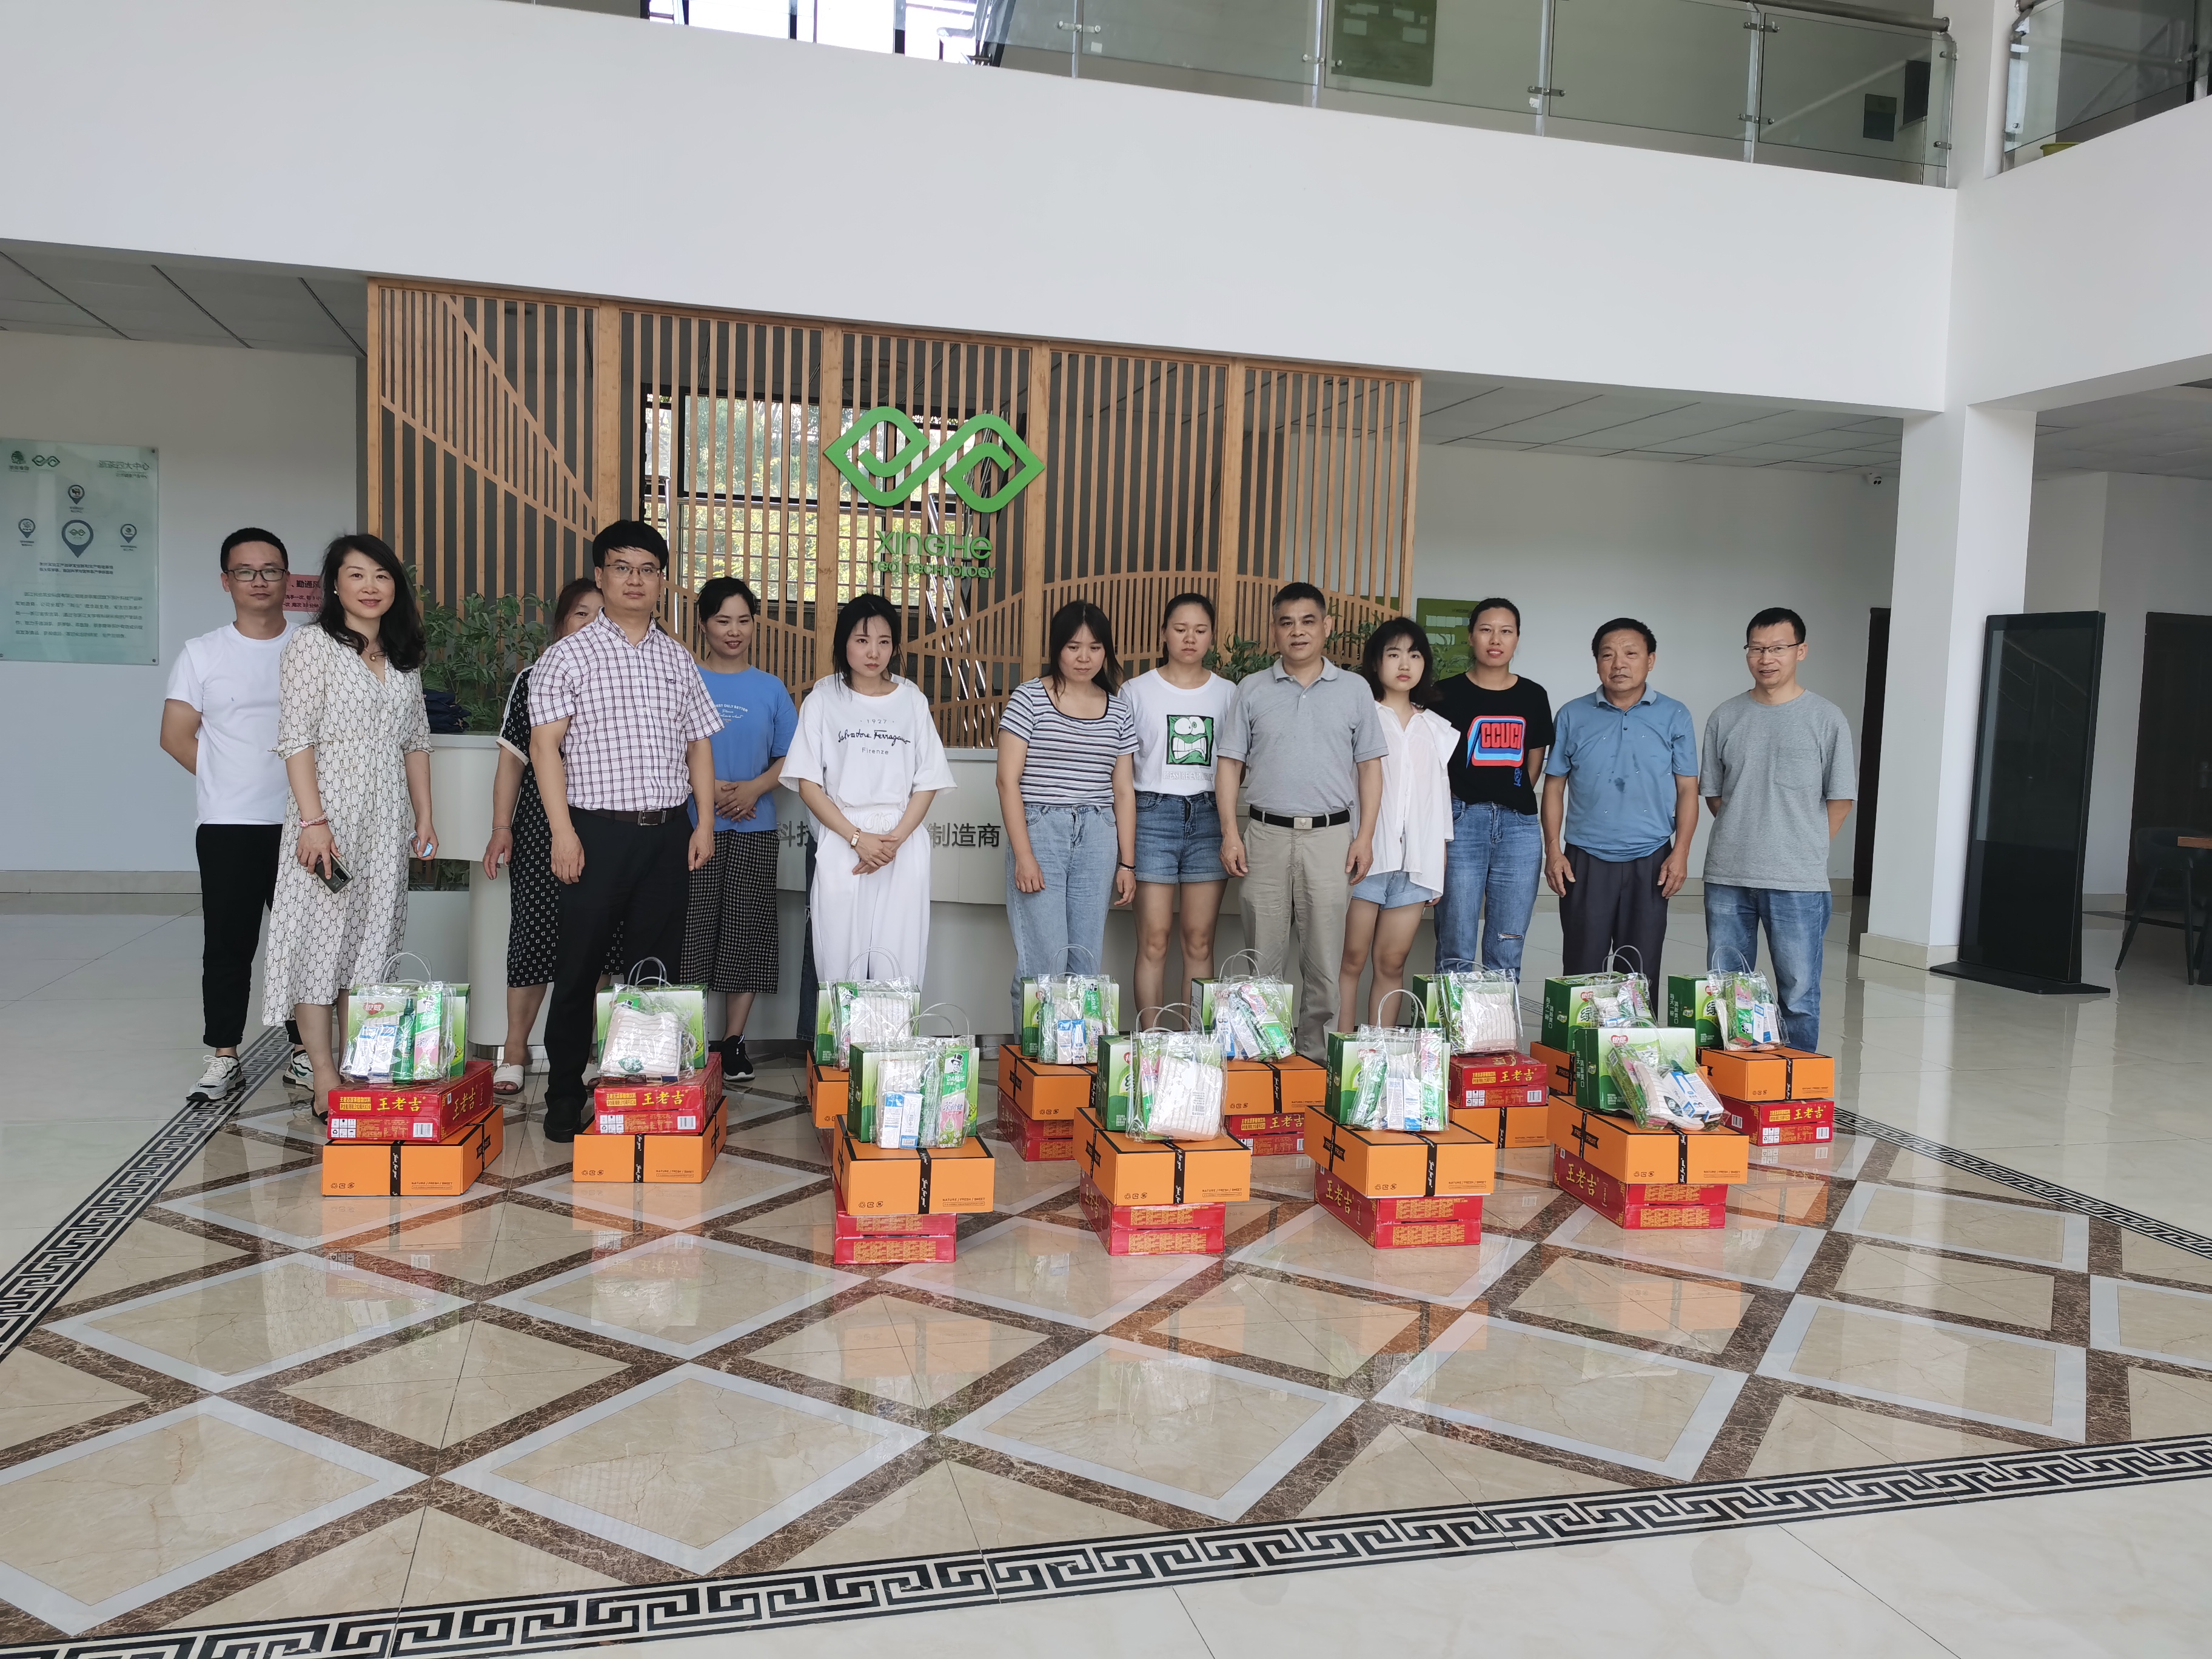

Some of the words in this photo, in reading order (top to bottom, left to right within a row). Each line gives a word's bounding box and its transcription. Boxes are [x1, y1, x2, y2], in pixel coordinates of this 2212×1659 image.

[838, 729, 872, 743] Salvatore
[1500, 1068, 1534, 1083] 王老吉
[377, 1096, 423, 1111] 王老吉
[642, 1090, 685, 1106] 王老吉
[1269, 1114, 1305, 1128] 王老吉
[1794, 1107, 1824, 1120] 王老吉
[1566, 1163, 1597, 1196] 王老吉
[1326, 1179, 1352, 1215] 王老吉
